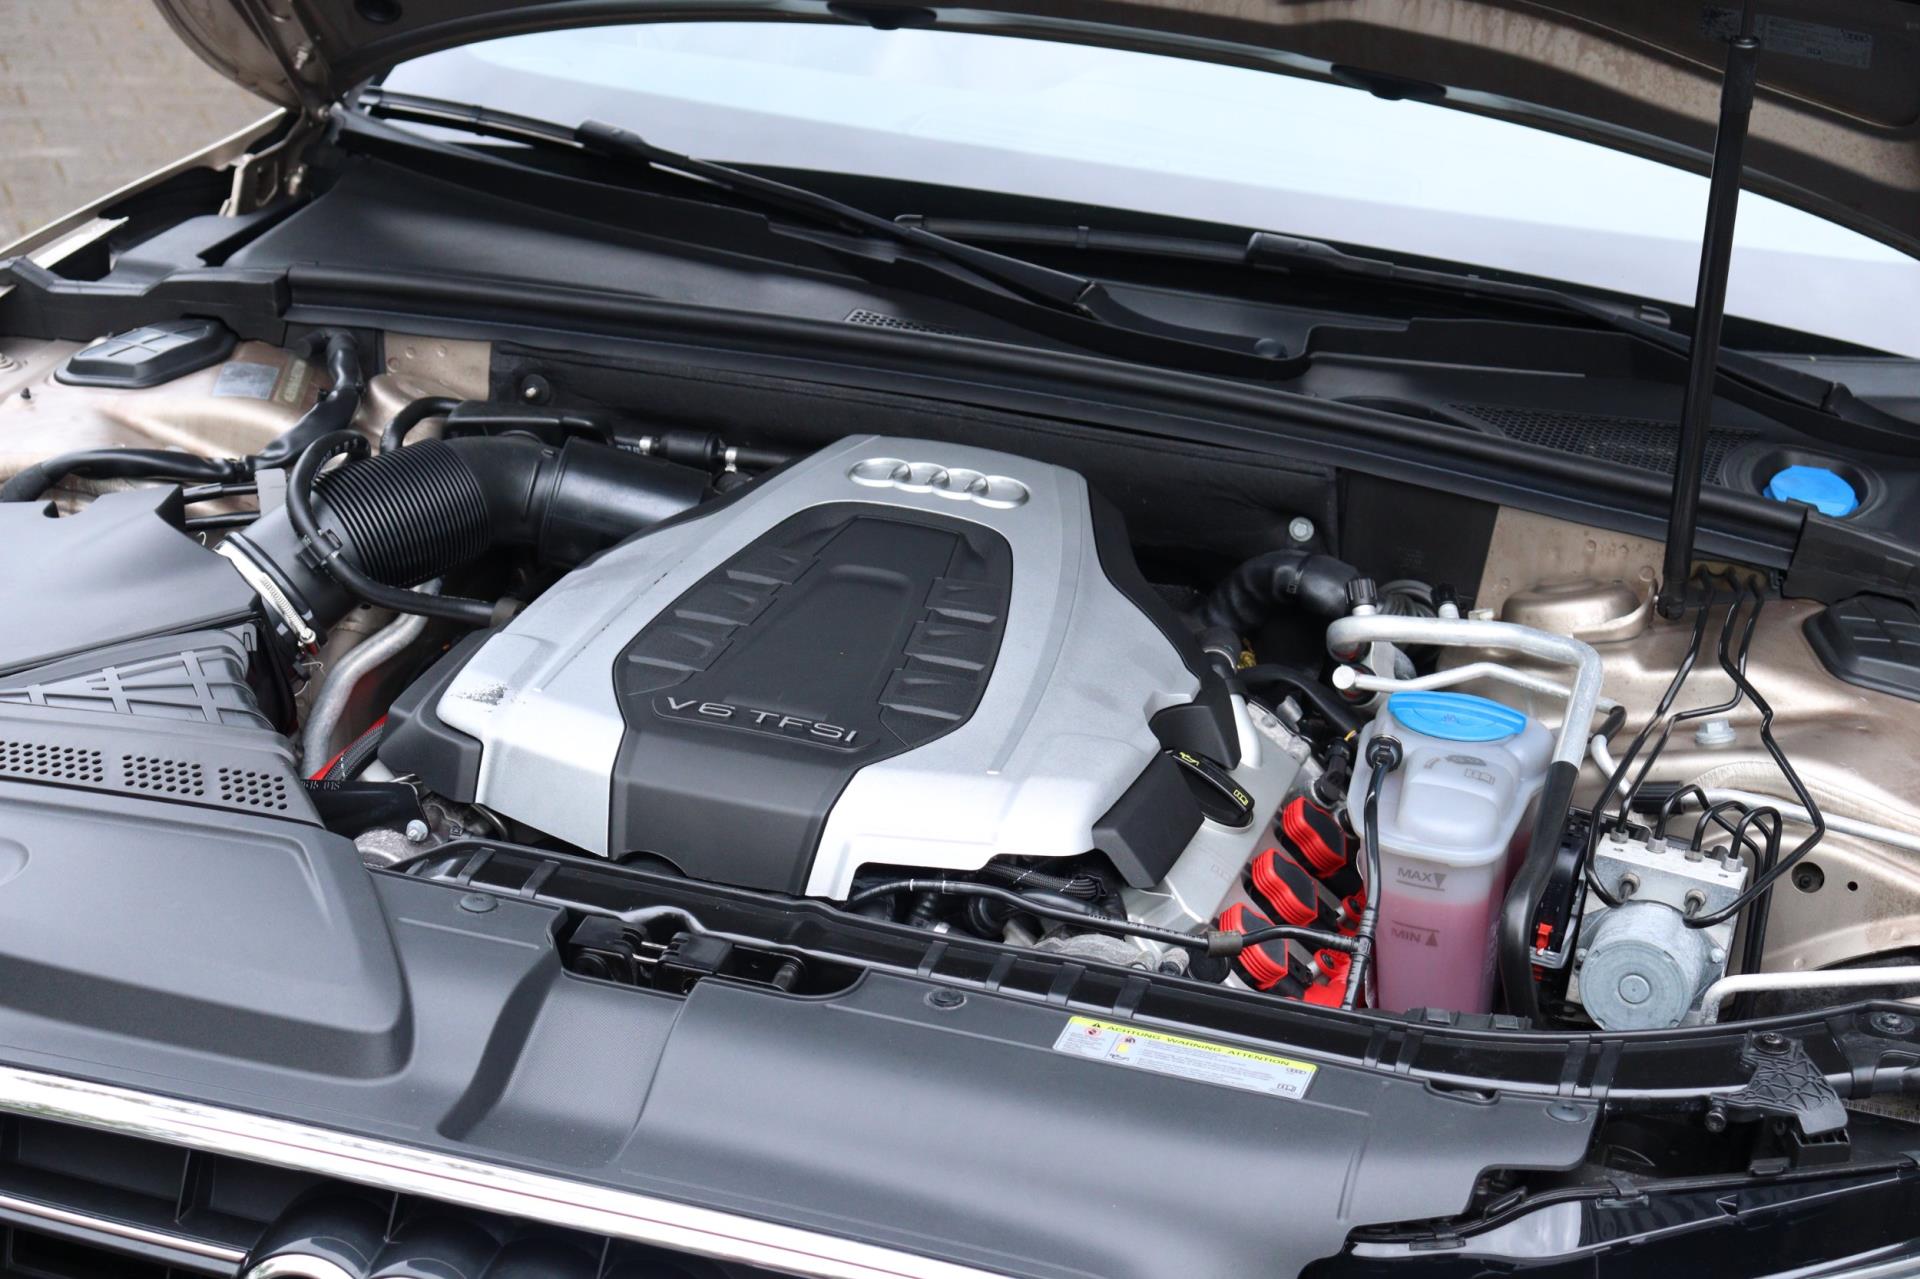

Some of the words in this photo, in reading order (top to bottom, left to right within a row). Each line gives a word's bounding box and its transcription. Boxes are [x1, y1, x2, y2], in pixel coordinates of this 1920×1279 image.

[667, 697, 736, 717] V6
[750, 709, 857, 742] TFSI
[1397, 867, 1433, 883] MAX
[1391, 927, 1421, 942] MIN
[1107, 1025, 1161, 1040] ACHTUNG
[1167, 1037, 1221, 1052] WARNING
[1228, 1049, 1290, 1066] ATTENTION
